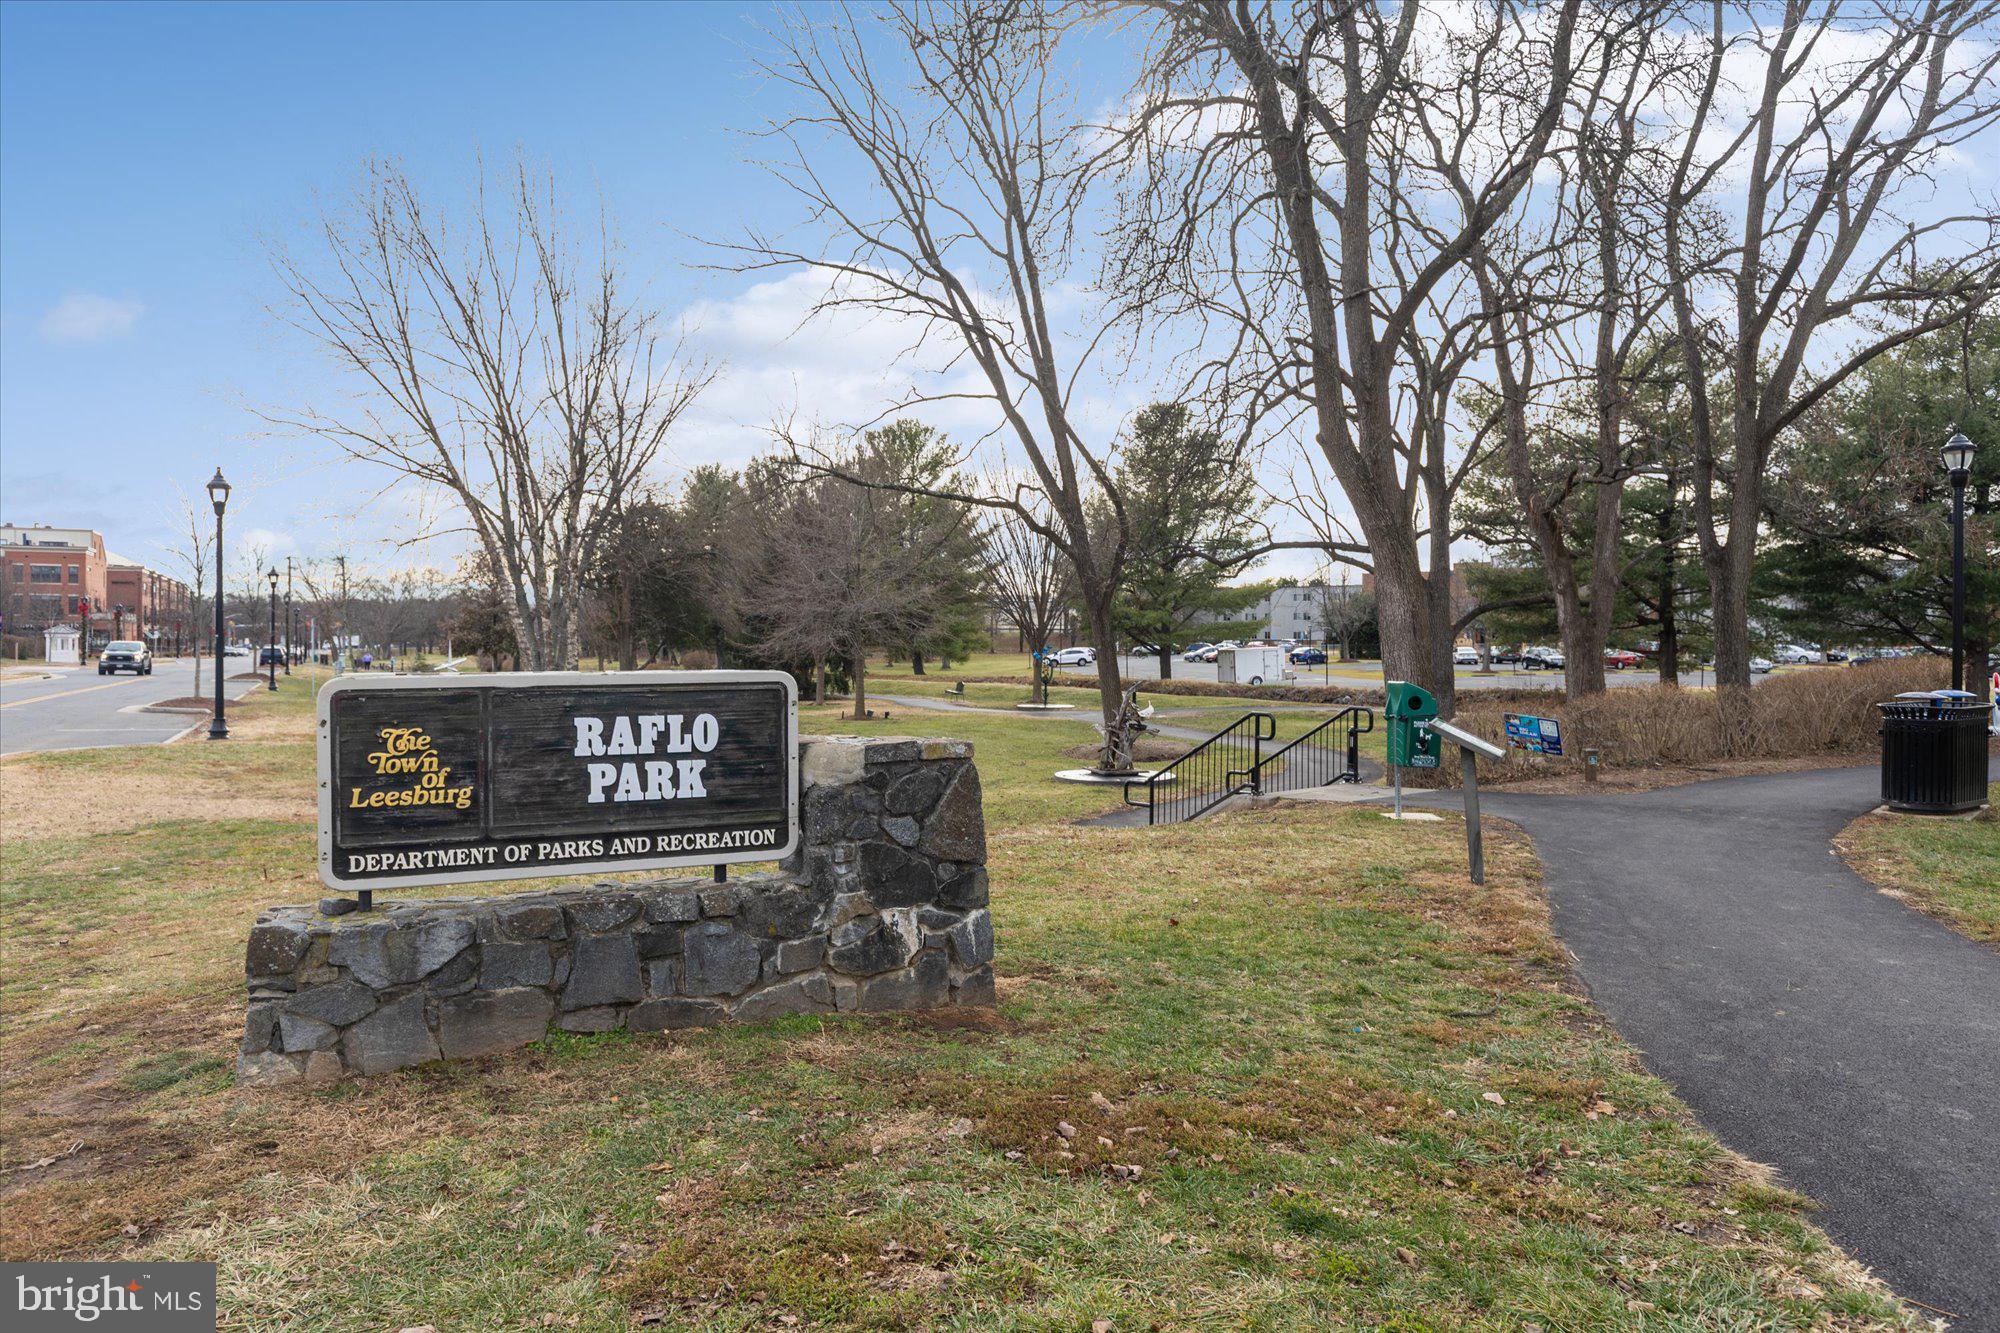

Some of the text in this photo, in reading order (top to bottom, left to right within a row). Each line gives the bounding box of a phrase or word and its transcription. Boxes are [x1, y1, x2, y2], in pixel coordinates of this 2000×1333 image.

[381, 728, 431, 755] The
[574, 713, 719, 757] RAFLO
[367, 750, 439, 774] Town
[421, 767, 451, 788] of
[587, 759, 707, 803] PARK
[349, 785, 474, 809] Leesburg
[348, 829, 776, 873] DEPARTMENT OF PARKS AND RECREATION
